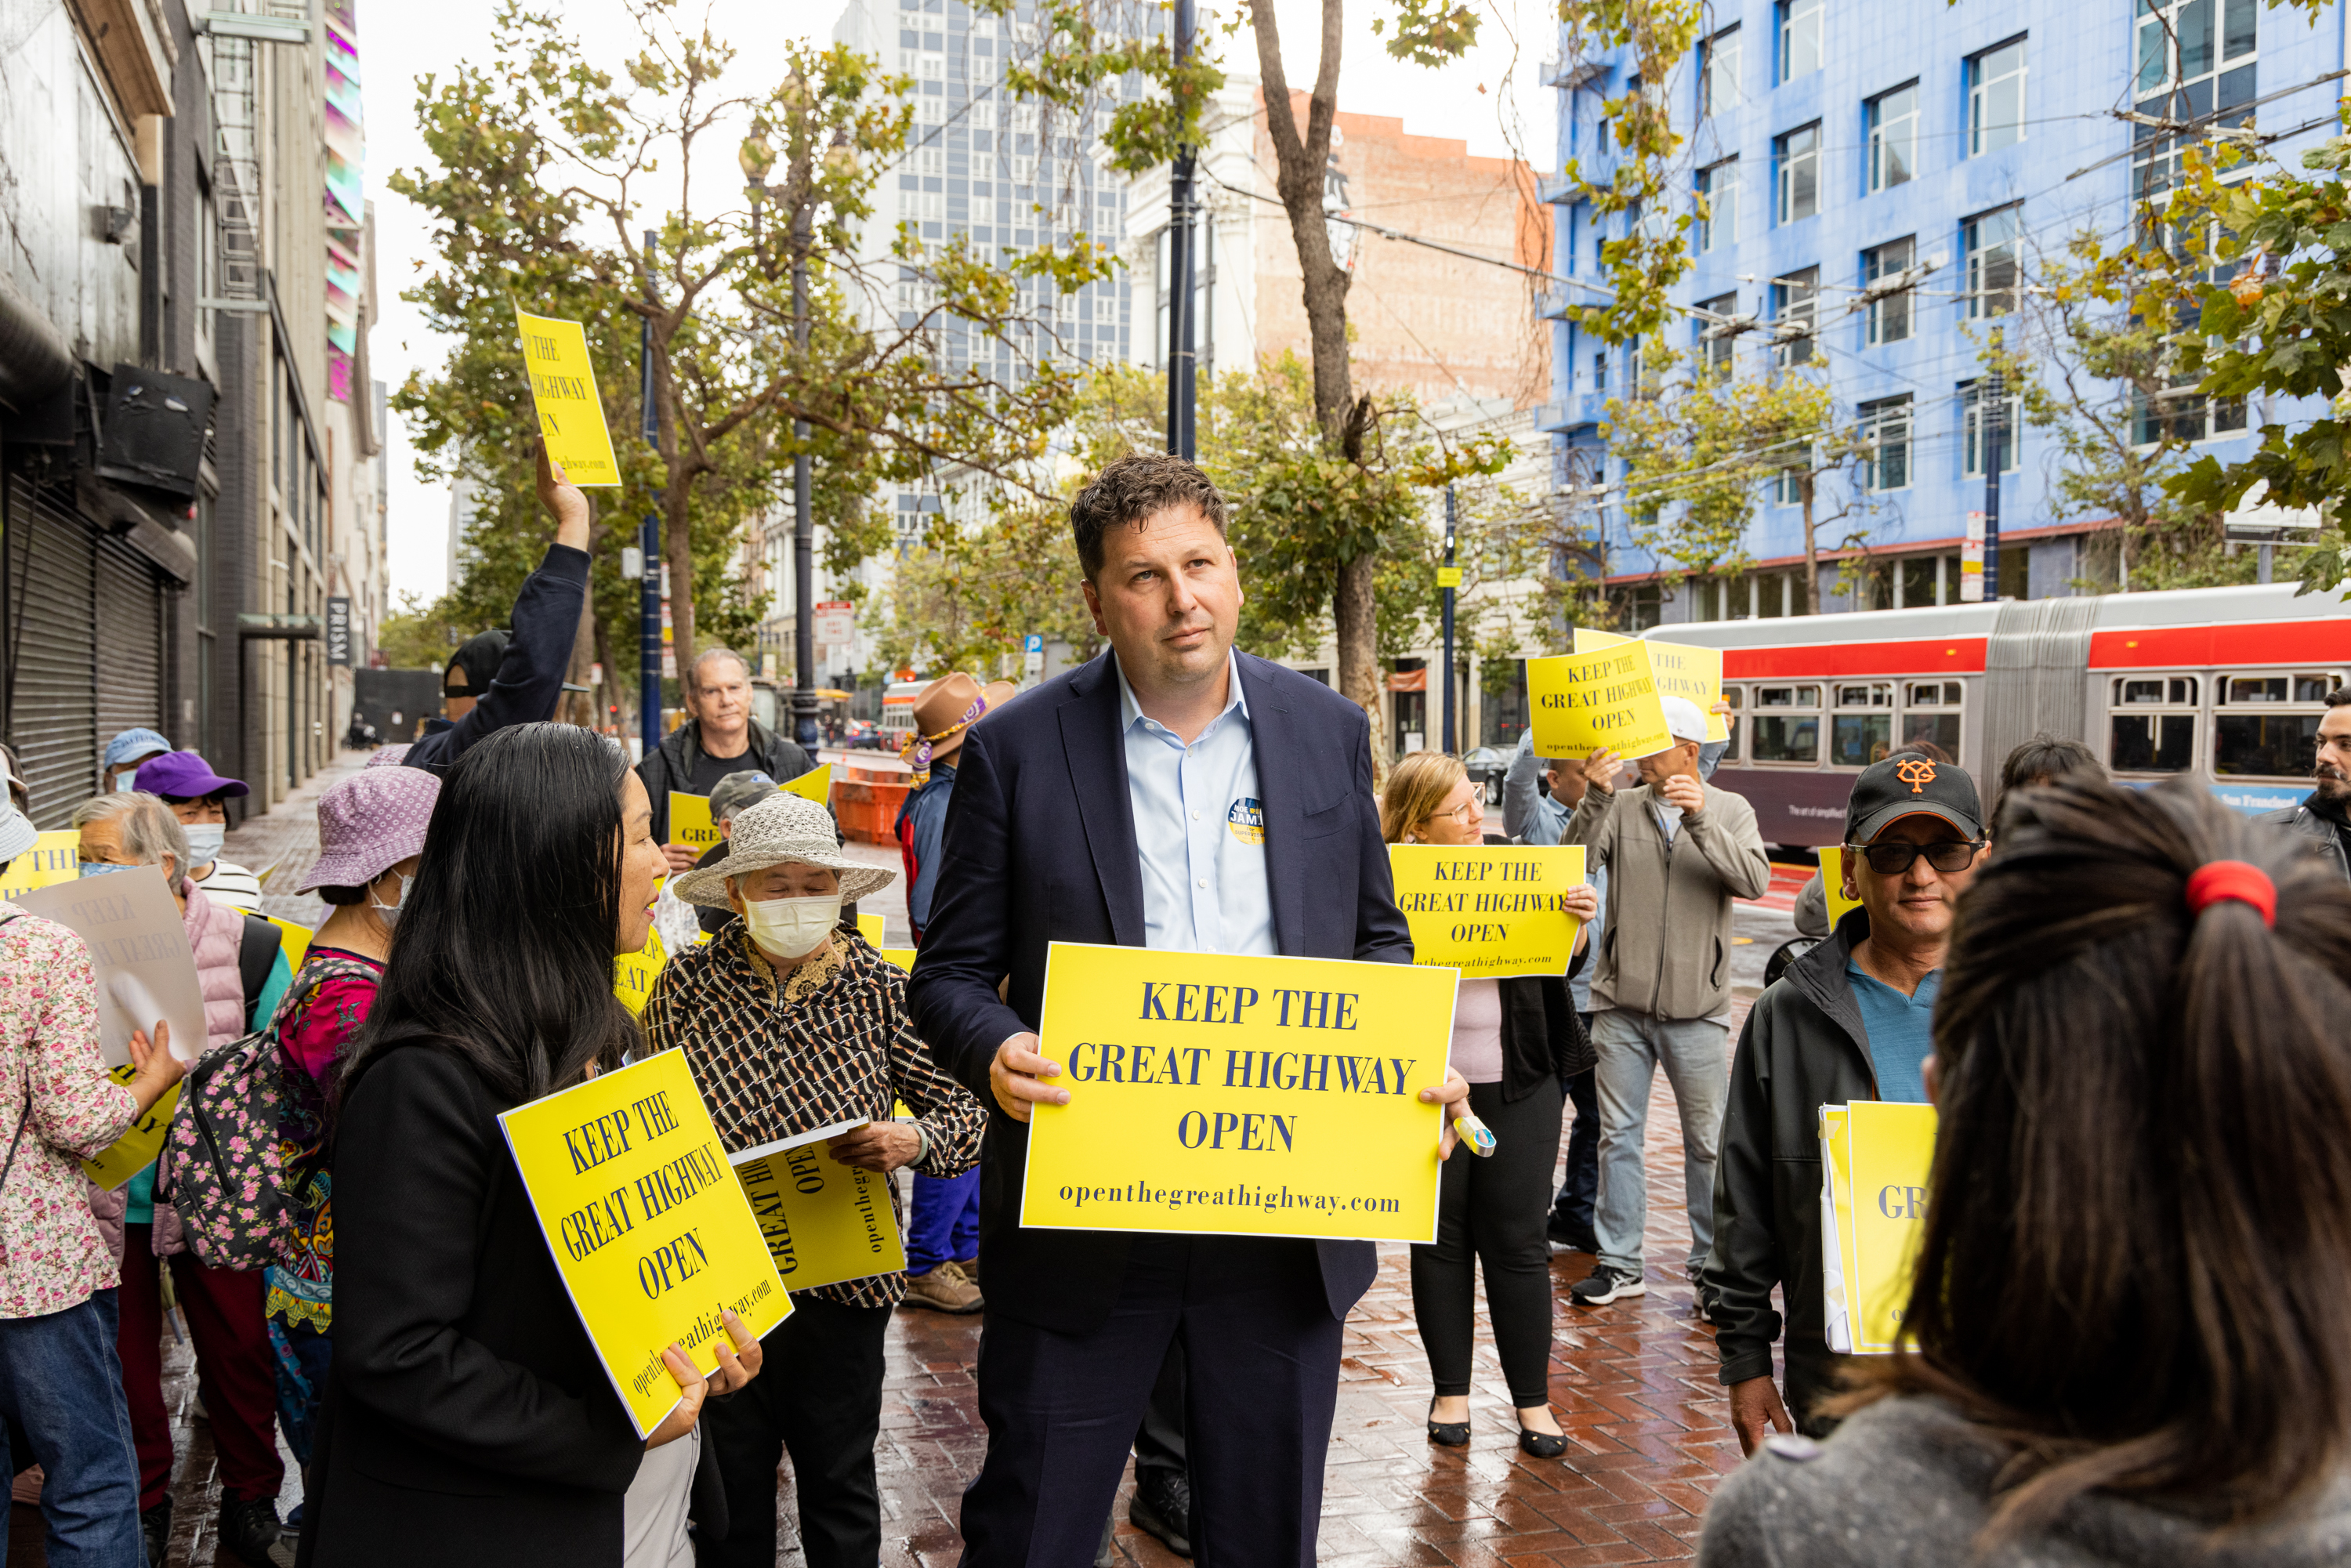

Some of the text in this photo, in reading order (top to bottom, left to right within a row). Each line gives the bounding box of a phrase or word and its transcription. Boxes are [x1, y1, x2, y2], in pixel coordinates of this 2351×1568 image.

[532, 335, 560, 361] THE
[330, 603, 347, 659] PRISM
[1567, 654, 1636, 683] KEEP THE
[1654, 653, 1687, 670] THE
[1541, 676, 1653, 708] GREAT HIGHWAY
[1592, 708, 1636, 731] OPEN
[1234, 804, 1248, 813] MOE
[1434, 861, 1542, 882] KEEP THE
[1400, 892, 1567, 913] GREAT HIGHWAY
[1451, 924, 1511, 943] OPEN
[1413, 954, 1552, 968] nthegreathighway.com
[1139, 982, 1360, 1030] KEEP THE
[1068, 1042, 1416, 1095] GREAT HIGHWAY
[562, 1090, 679, 1175] KEEP THE
[1178, 1110, 1298, 1153] OPEN
[784, 1145, 825, 1194] OPEN
[560, 1142, 723, 1262] GREAT HIGHWAY
[1060, 1180, 1400, 1215] openthegreathighway.com
[750, 1190, 799, 1275] GREAT
[638, 1227, 709, 1300] OPEN
